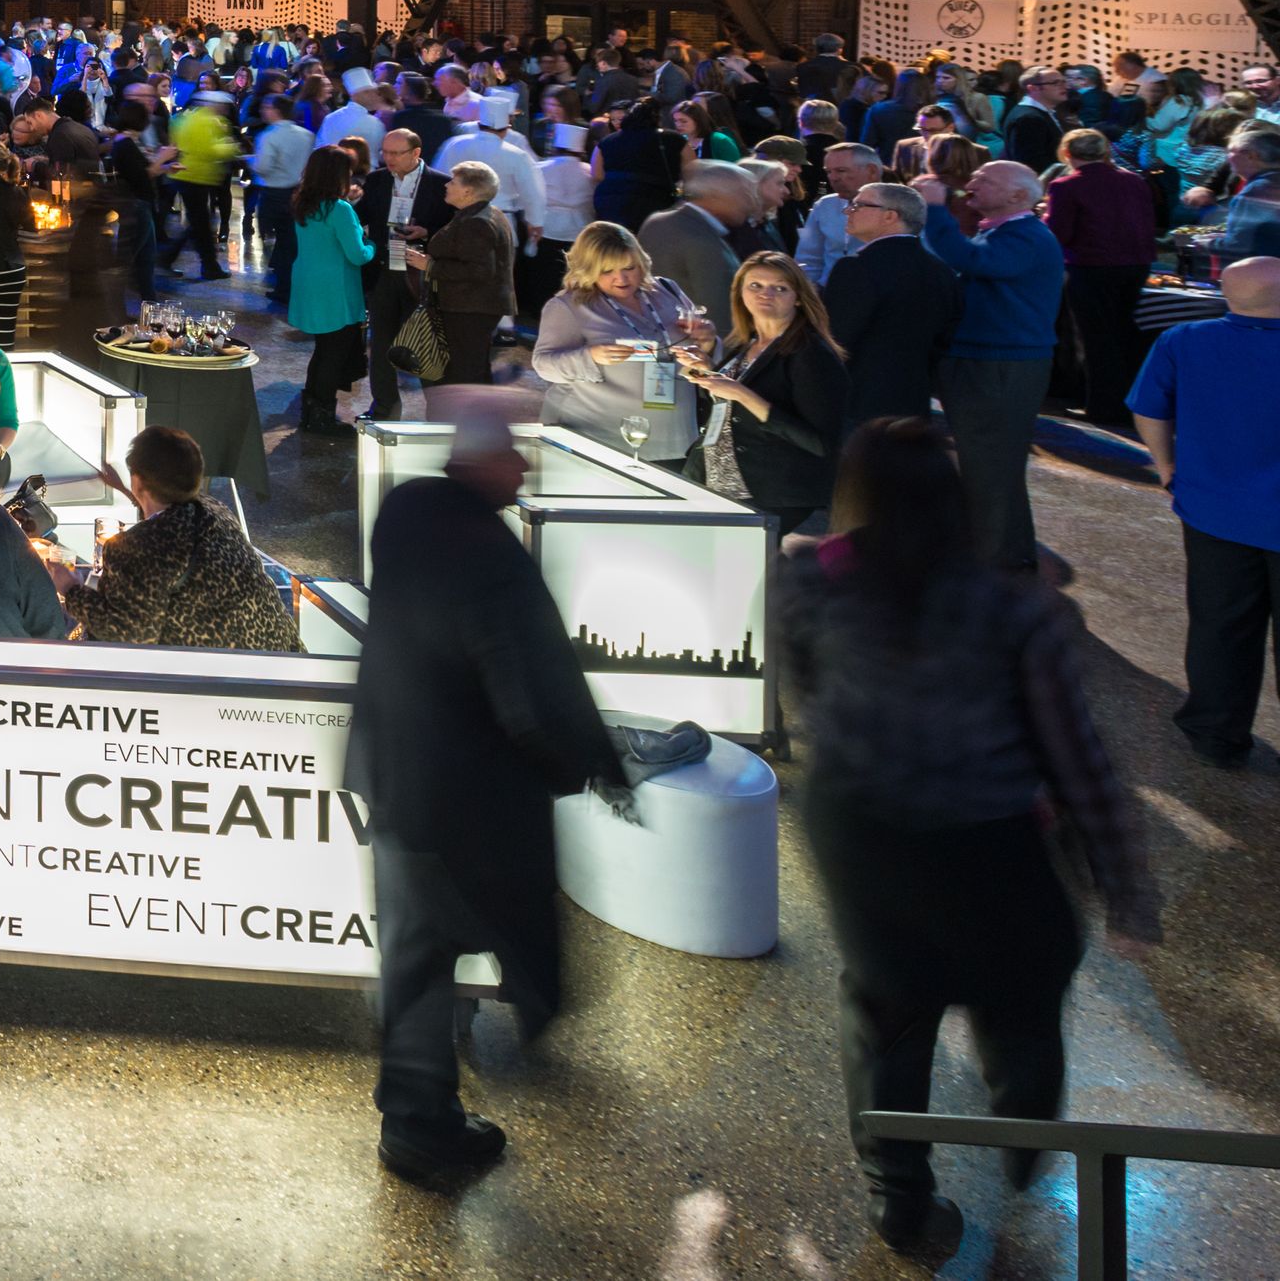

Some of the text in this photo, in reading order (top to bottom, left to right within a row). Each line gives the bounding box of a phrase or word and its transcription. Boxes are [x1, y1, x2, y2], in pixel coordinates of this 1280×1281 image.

[1134, 13, 1249, 26] SPIAGGIA
[104, 743, 316, 774] EVENTCREATIVE
[87, 893, 377, 948] EVENTCREA
